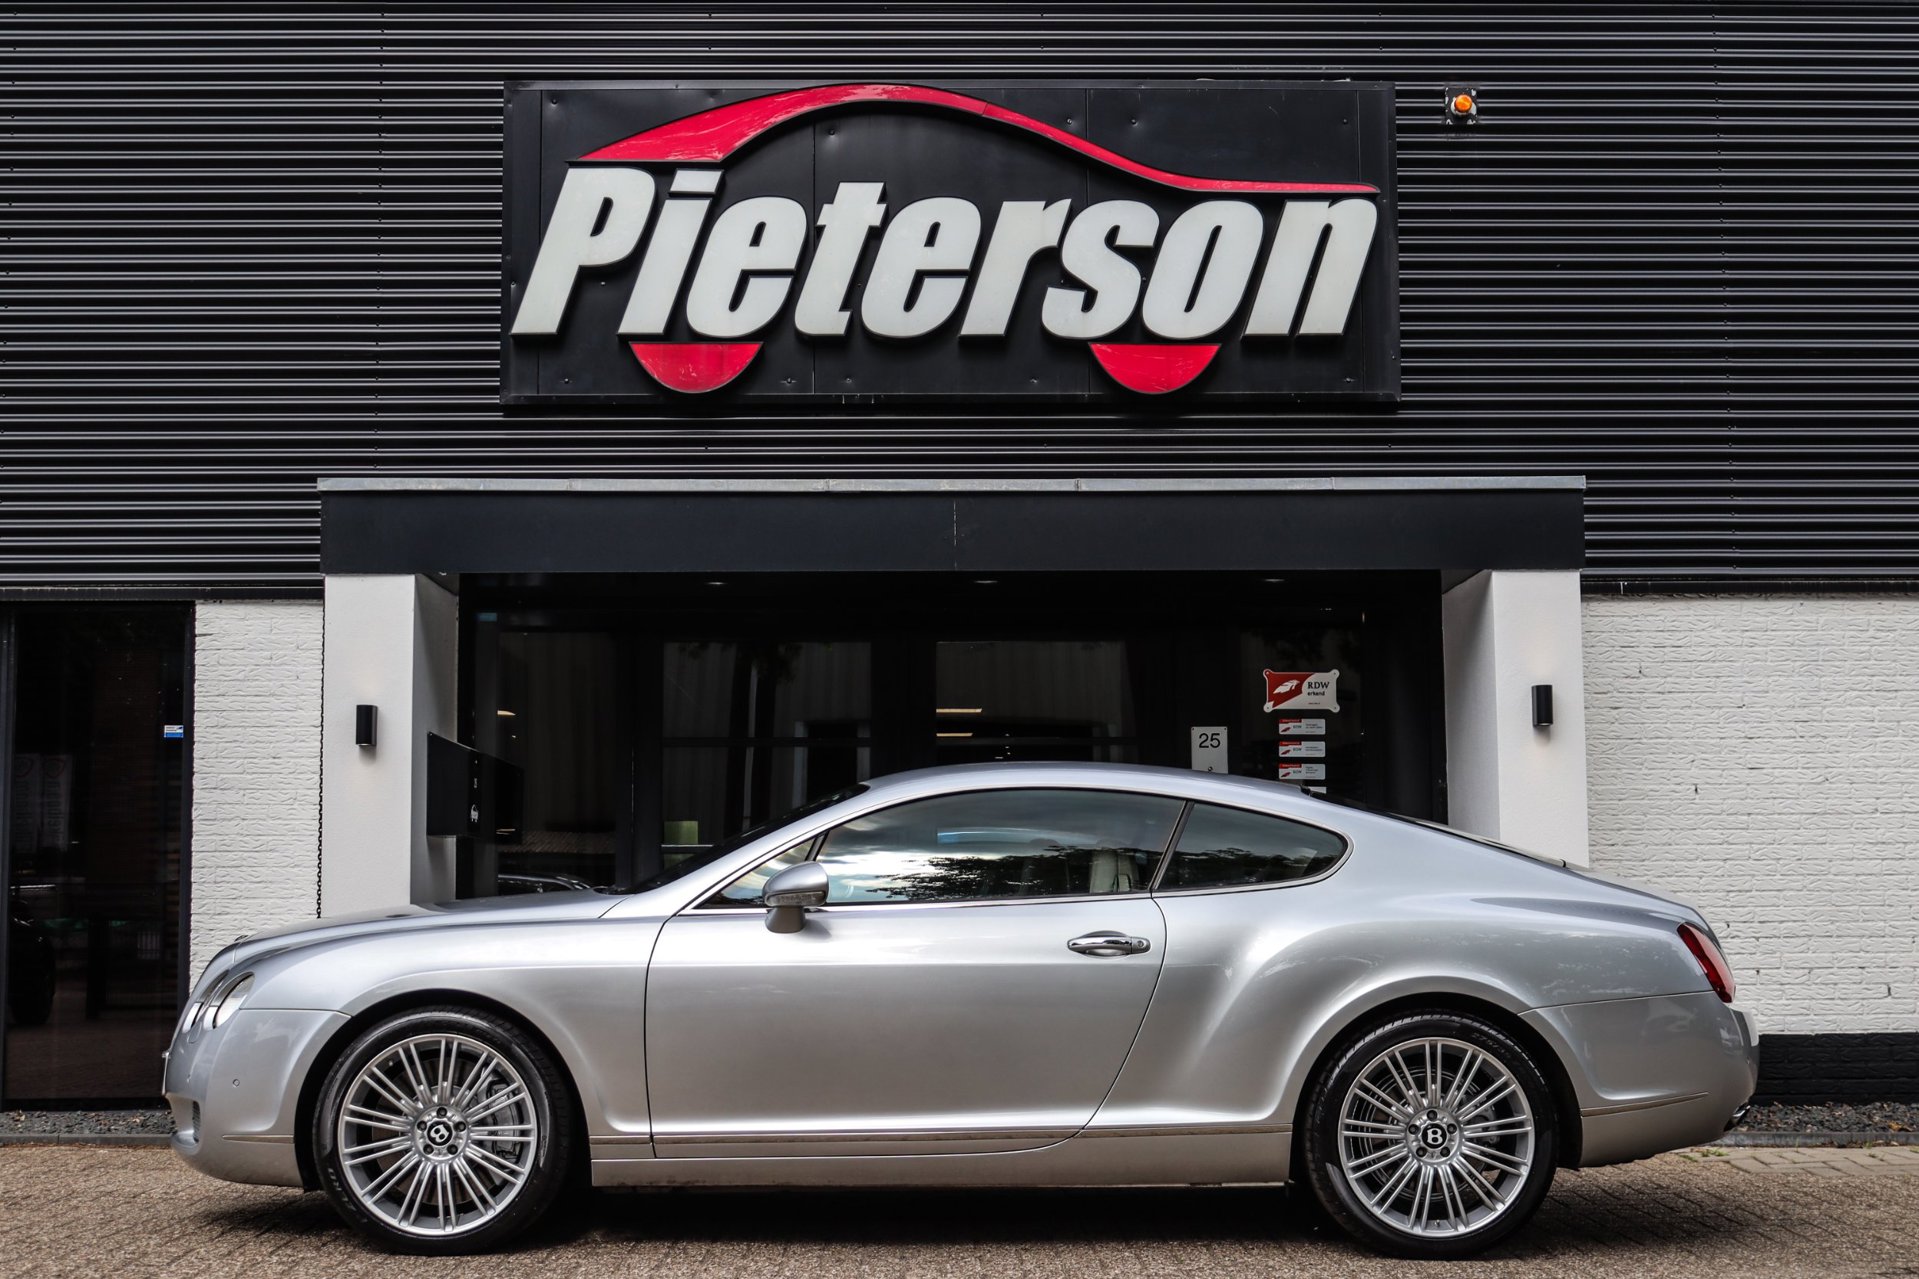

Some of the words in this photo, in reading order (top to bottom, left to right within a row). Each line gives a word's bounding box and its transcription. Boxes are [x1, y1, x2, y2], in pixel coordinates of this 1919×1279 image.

[510, 167, 1378, 340] Pieterson
[1307, 681, 1330, 690] RDW
[1198, 732, 1221, 749] 25
[1427, 1128, 1443, 1145] B
